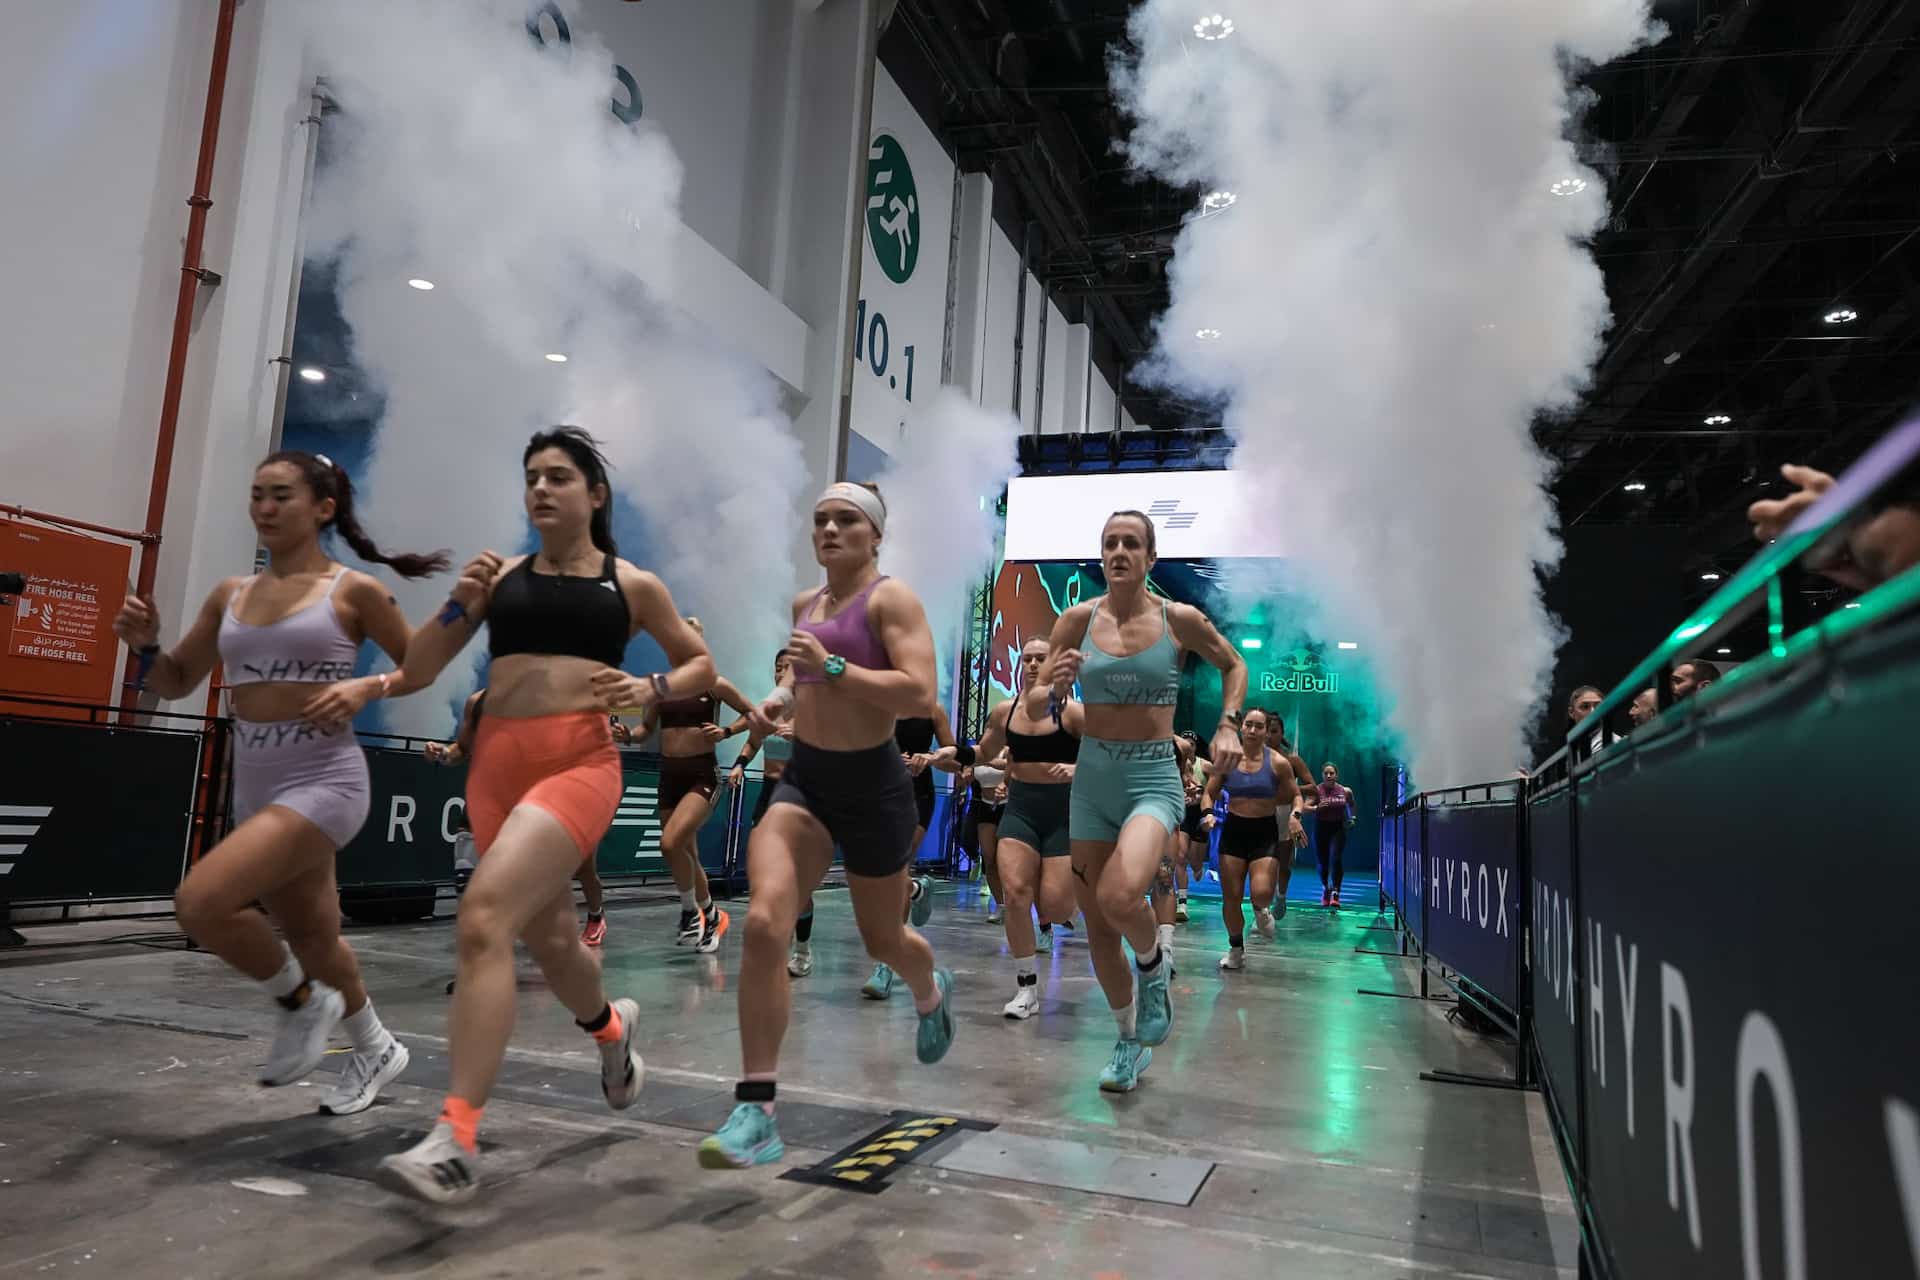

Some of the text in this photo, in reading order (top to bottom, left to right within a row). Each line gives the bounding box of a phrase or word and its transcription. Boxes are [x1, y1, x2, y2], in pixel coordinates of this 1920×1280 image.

[855, 299, 914, 402] 10.1
[25, 584, 97, 604] FIRE HOSE REEL
[19, 645, 88, 662] FIRE HOSE REEL
[248, 720, 336, 748] HYR
[1116, 742, 1174, 761] HYR
[1431, 856, 1508, 938] HYROX
